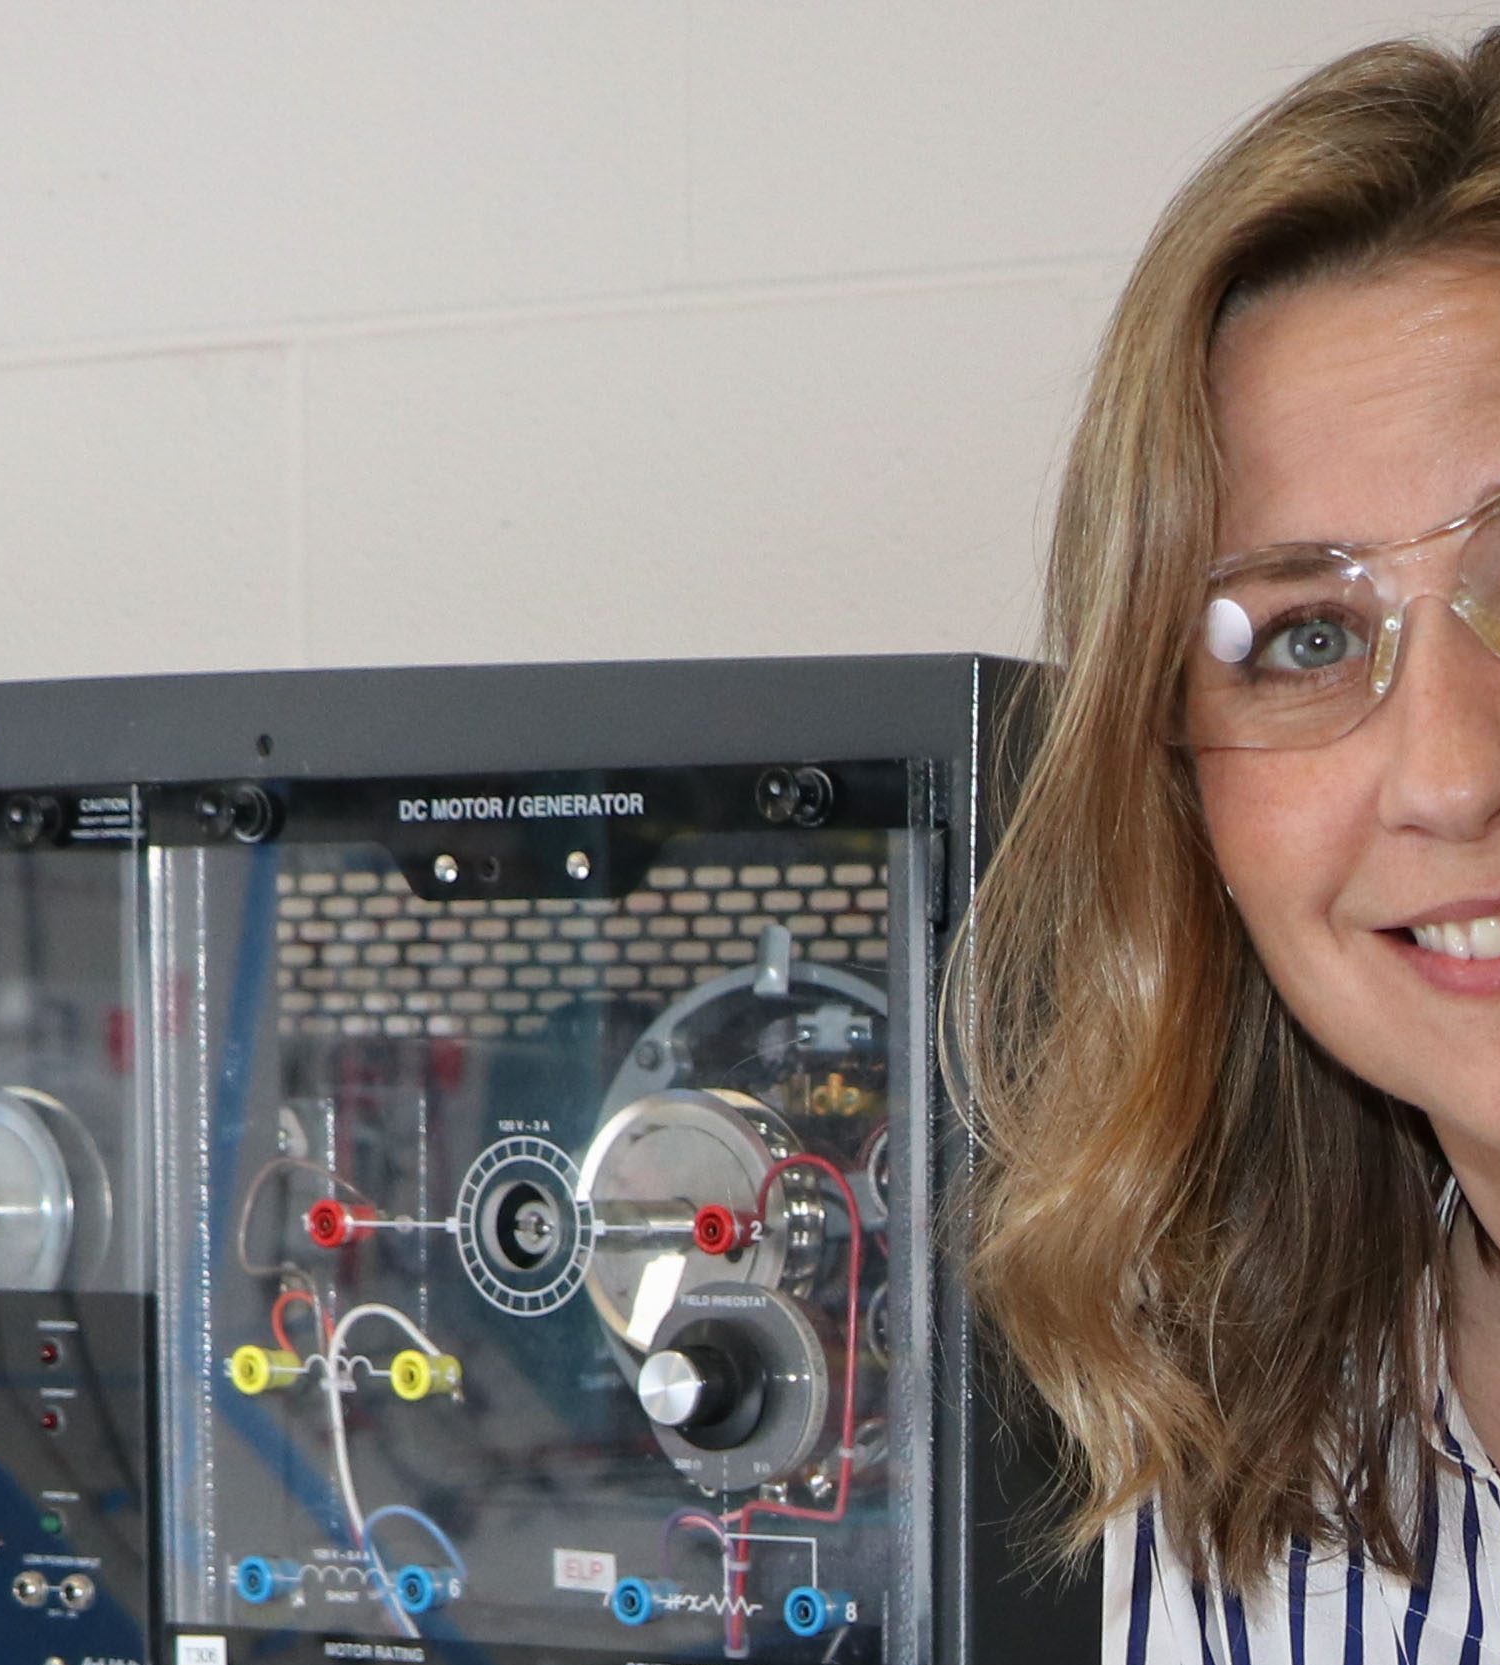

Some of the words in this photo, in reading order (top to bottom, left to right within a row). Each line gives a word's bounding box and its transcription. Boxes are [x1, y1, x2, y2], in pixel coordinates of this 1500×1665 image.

[399, 799, 428, 821] DC
[431, 797, 503, 820] MOTOR
[518, 793, 644, 818] GENERATOR
[750, 1221, 764, 1240] 2
[843, 1601, 858, 1623] 8
